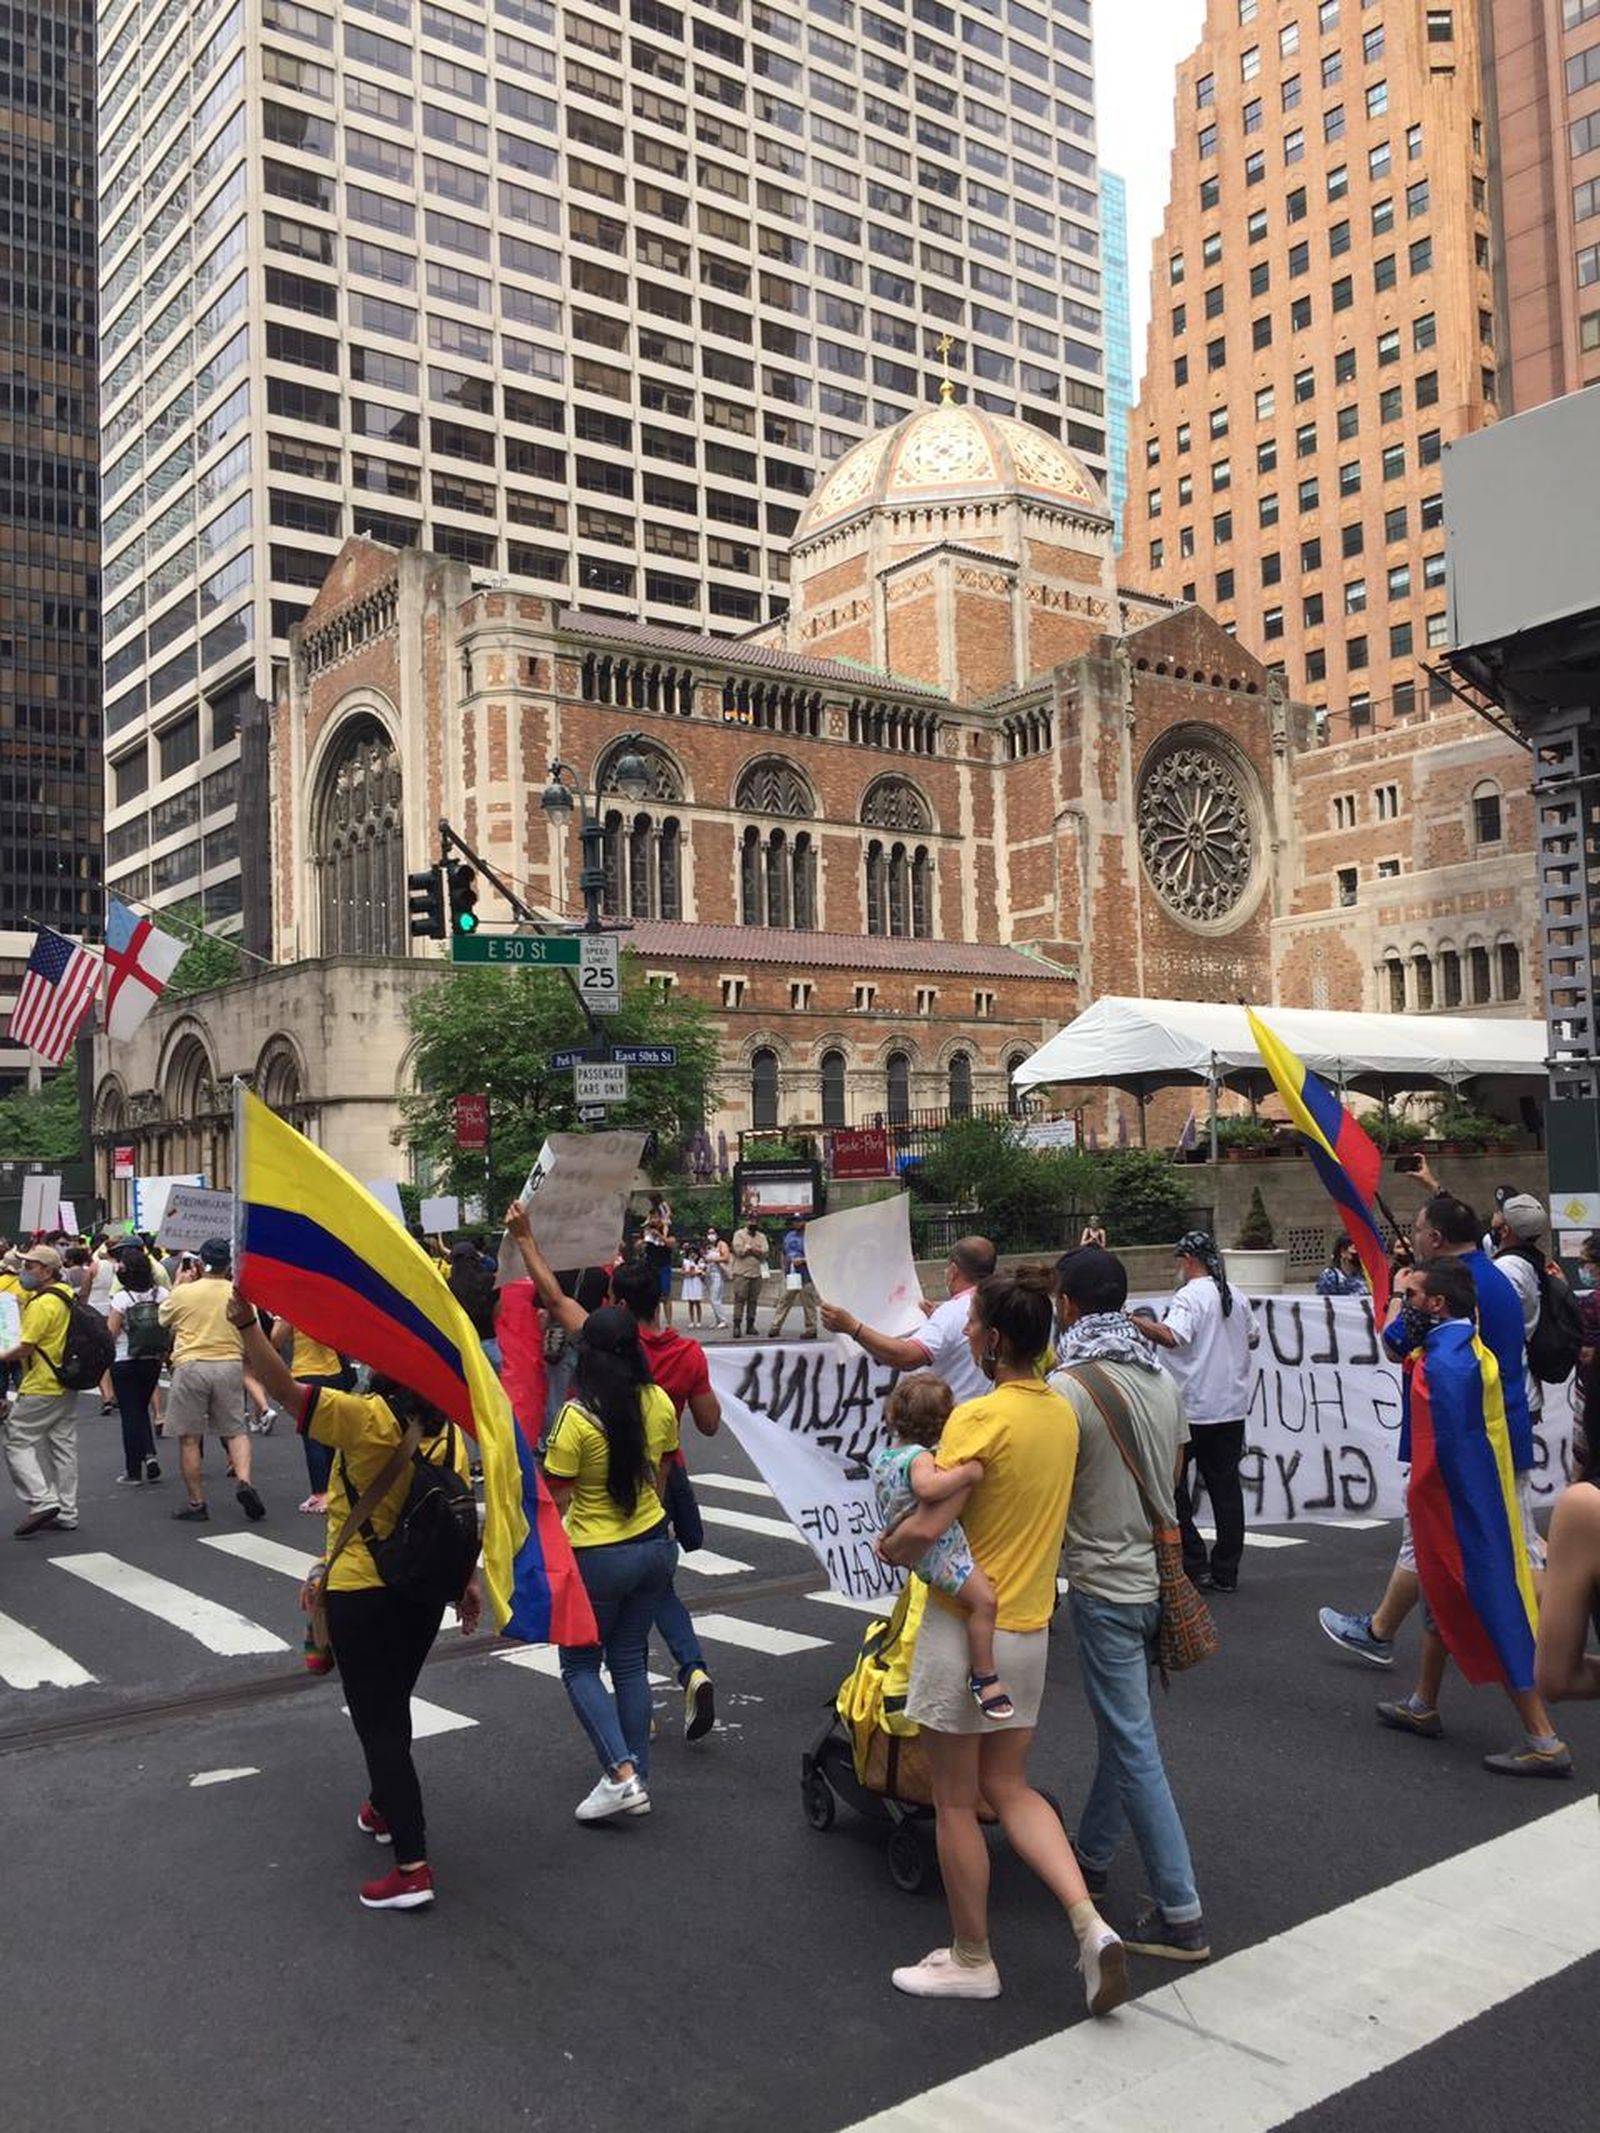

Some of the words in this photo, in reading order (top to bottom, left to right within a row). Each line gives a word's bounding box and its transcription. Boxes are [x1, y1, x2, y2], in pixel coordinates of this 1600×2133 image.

[488, 942, 499, 959] E
[504, 942, 525, 960] 50
[530, 943, 547, 960] St
[583, 967, 615, 988] 25
[614, 1050, 637, 1062] East
[639, 1051, 659, 1063] 50th
[660, 1051, 672, 1063] St
[577, 1068, 624, 1081] PASSENGER
[577, 1083, 600, 1096] CARS
[604, 1083, 624, 1096] ONLY
